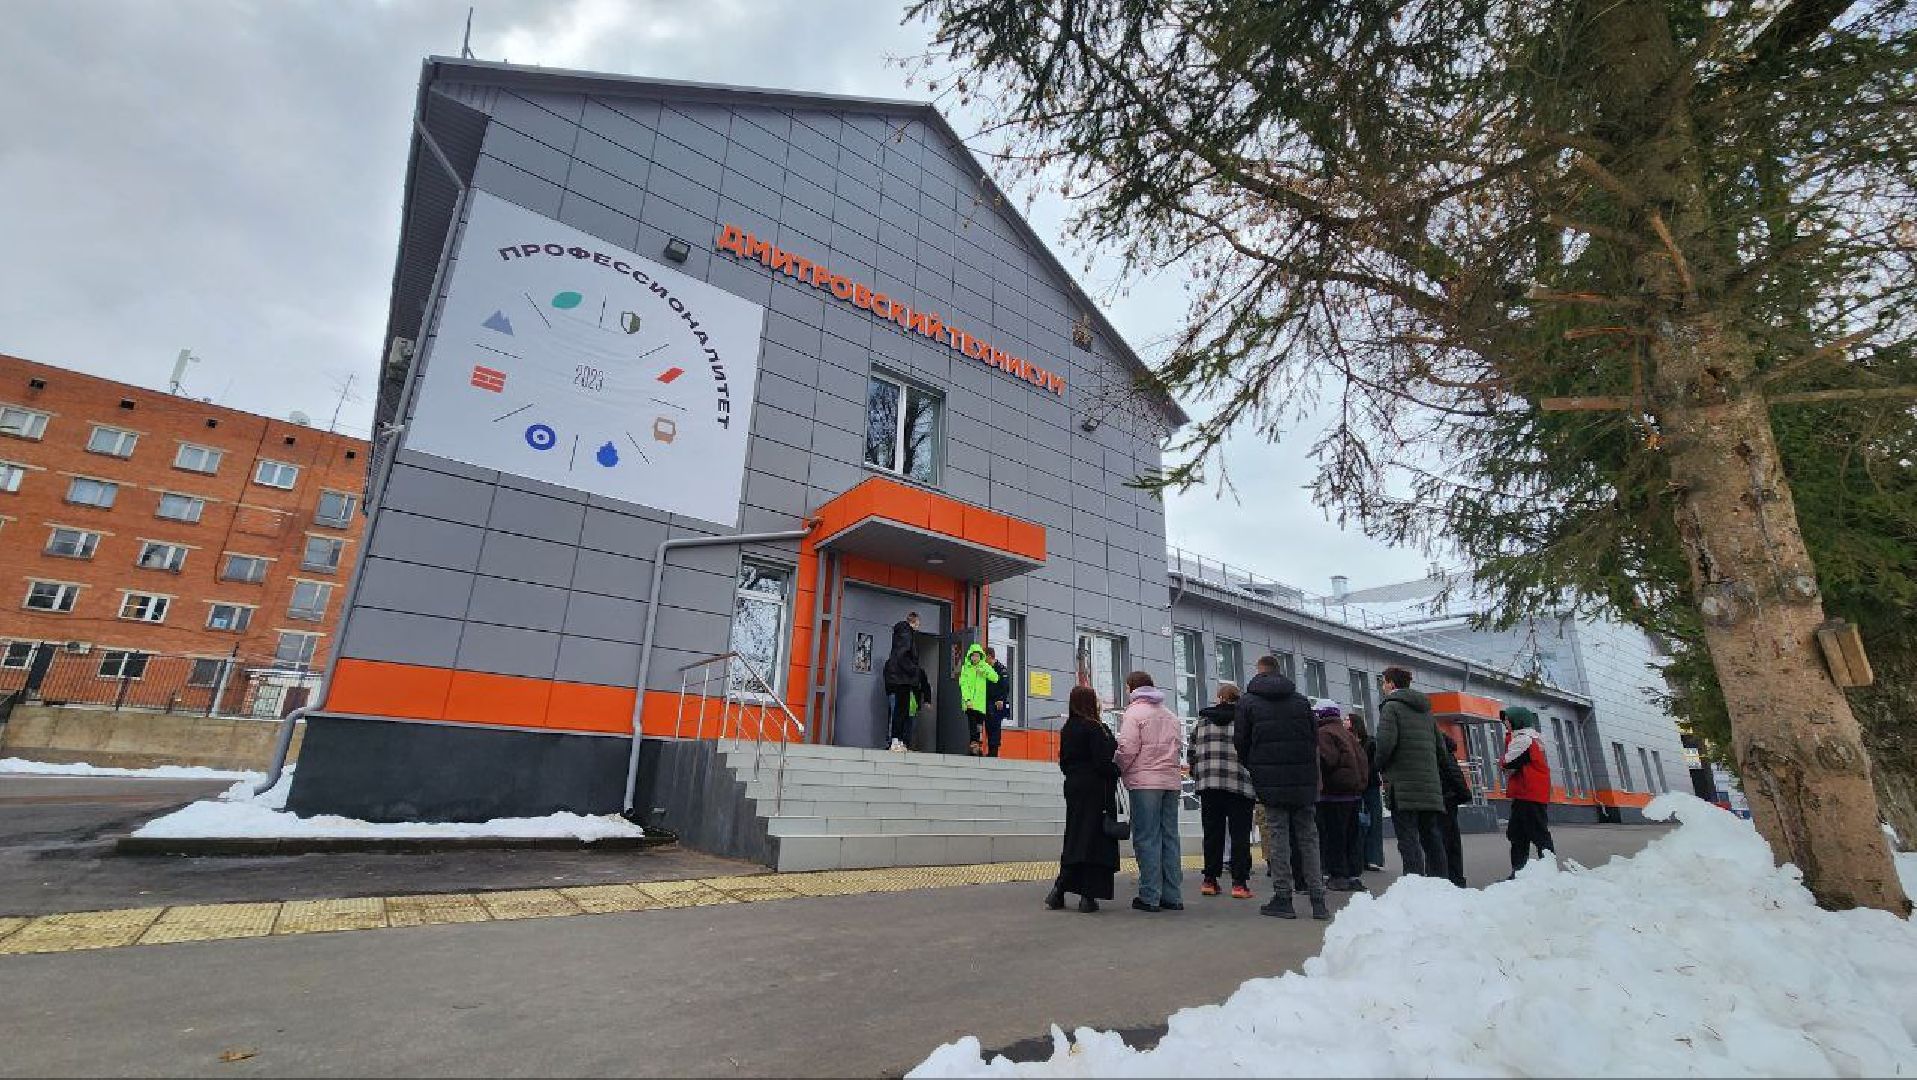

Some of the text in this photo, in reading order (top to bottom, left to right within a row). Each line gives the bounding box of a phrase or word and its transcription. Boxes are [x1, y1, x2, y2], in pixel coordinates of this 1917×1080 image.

[497, 243, 731, 430] ПРОФЕССИОНАЛИТЕТ
[574, 364, 604, 392] 2023
[716, 224, 1067, 396] ДМИТРОВСКИЙ ТЕХНИКУМ
